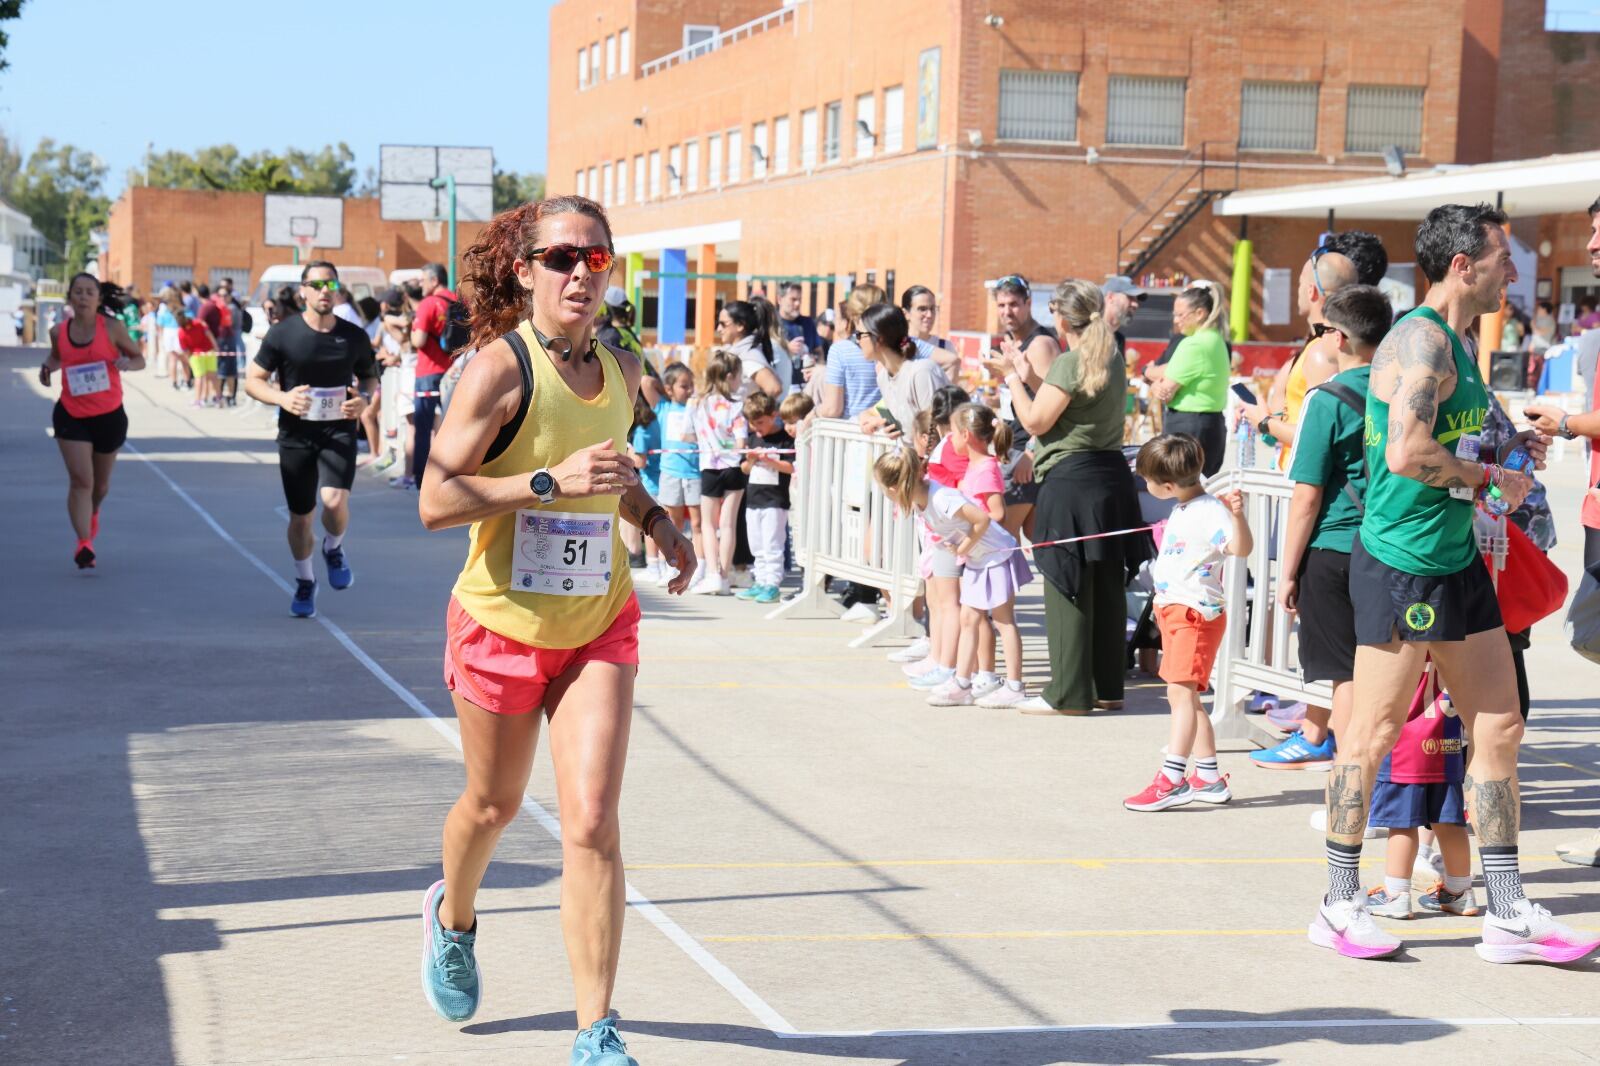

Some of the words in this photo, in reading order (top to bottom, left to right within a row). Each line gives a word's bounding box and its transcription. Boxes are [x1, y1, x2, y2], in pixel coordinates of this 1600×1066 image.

[321, 398, 334, 409] 98
[1446, 408, 1473, 430] VIA
[562, 539, 588, 565] 51
